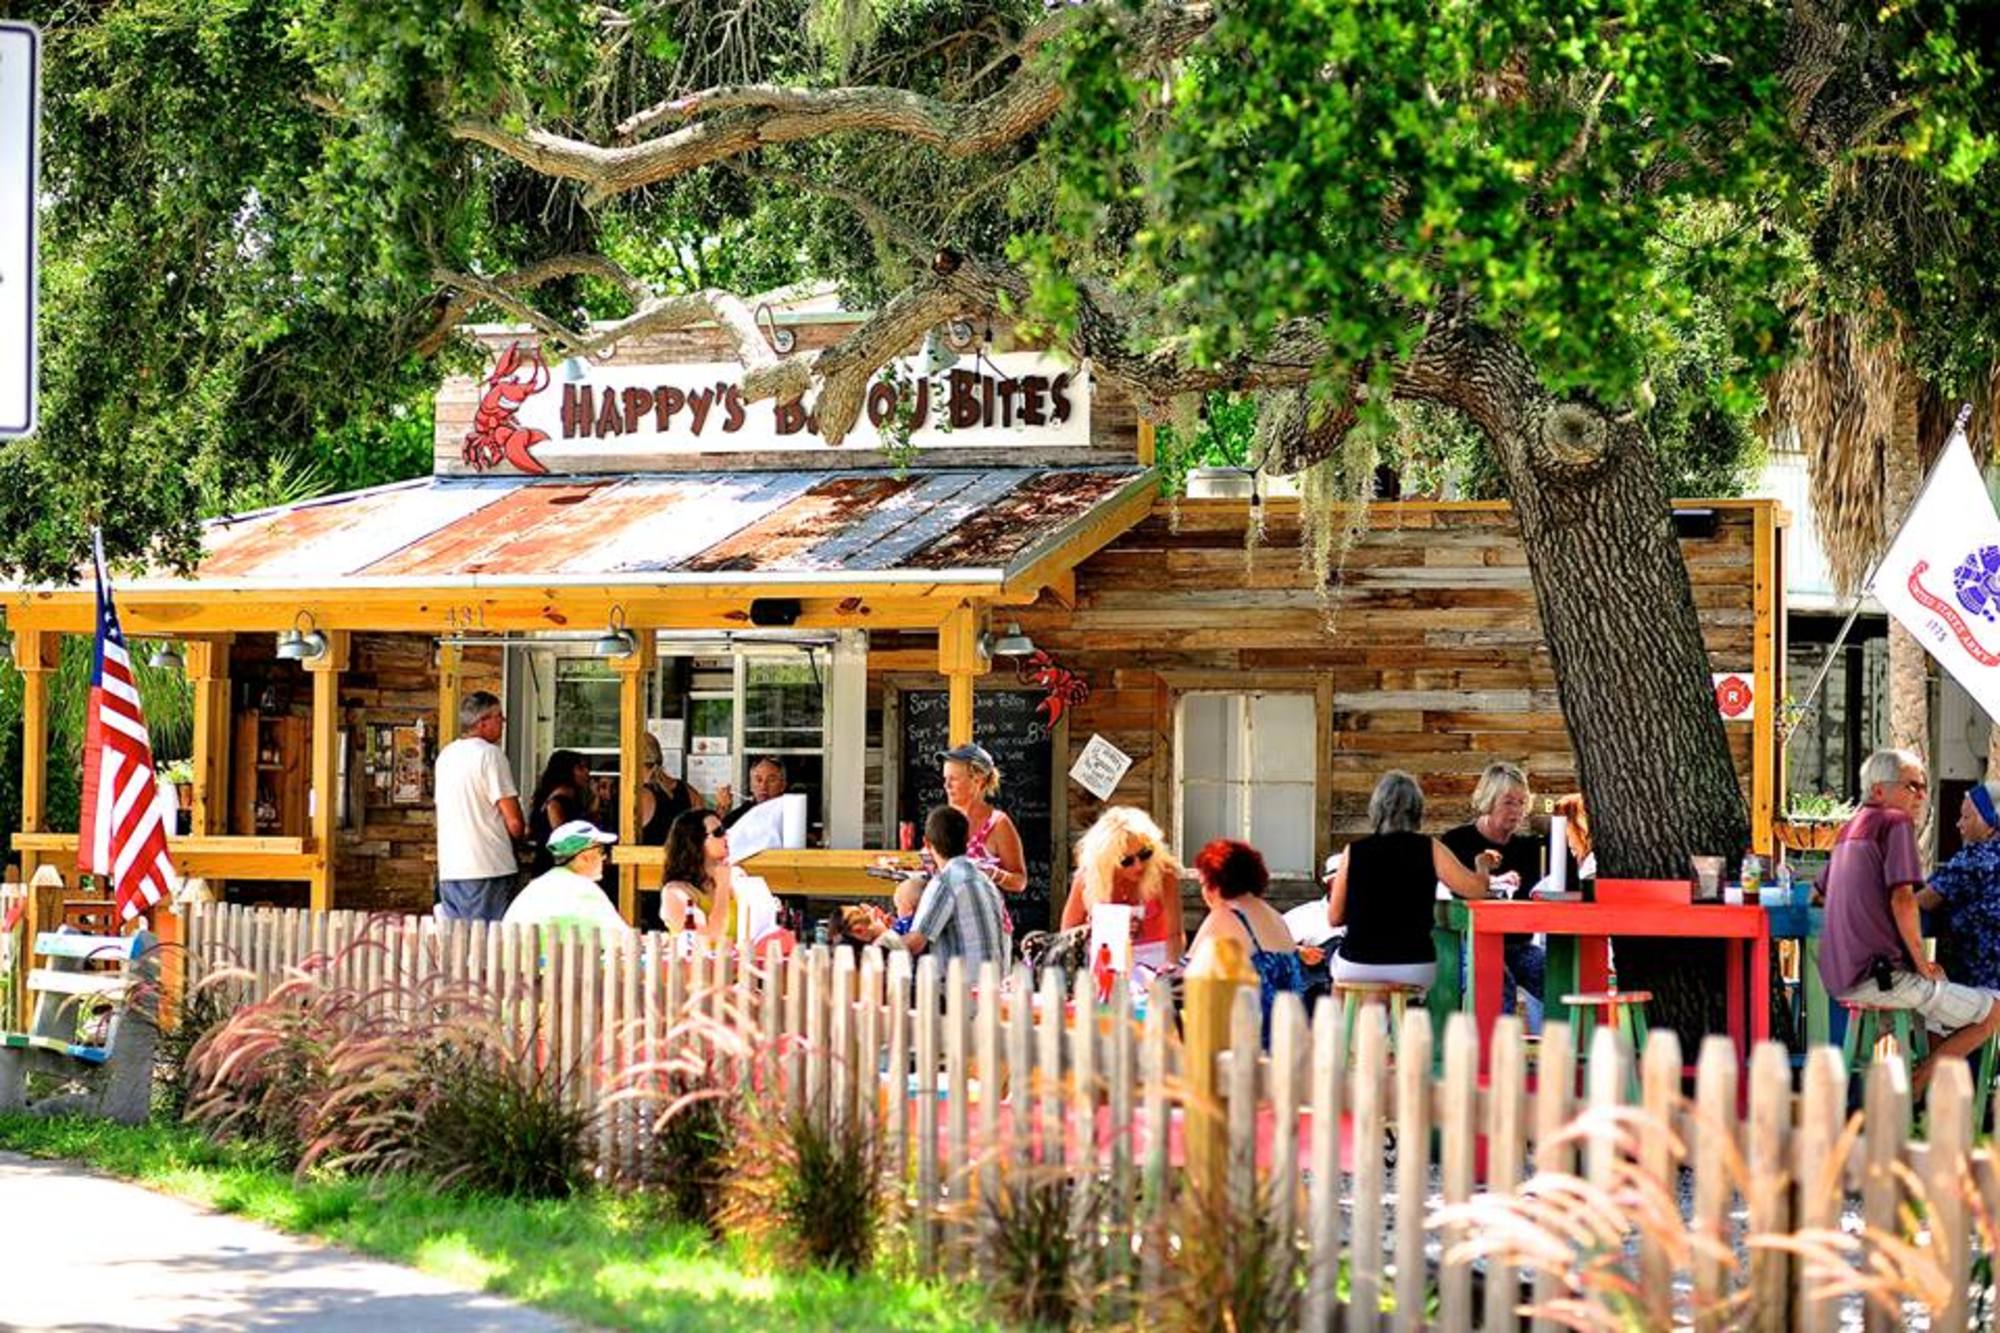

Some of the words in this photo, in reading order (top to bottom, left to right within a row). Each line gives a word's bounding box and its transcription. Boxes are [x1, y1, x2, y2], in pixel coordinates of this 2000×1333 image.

[560, 382, 746, 439] HAPPY'S
[944, 368, 1072, 430] BITES
[1926, 619, 1948, 642] 1775
[1728, 691, 1738, 702] R
